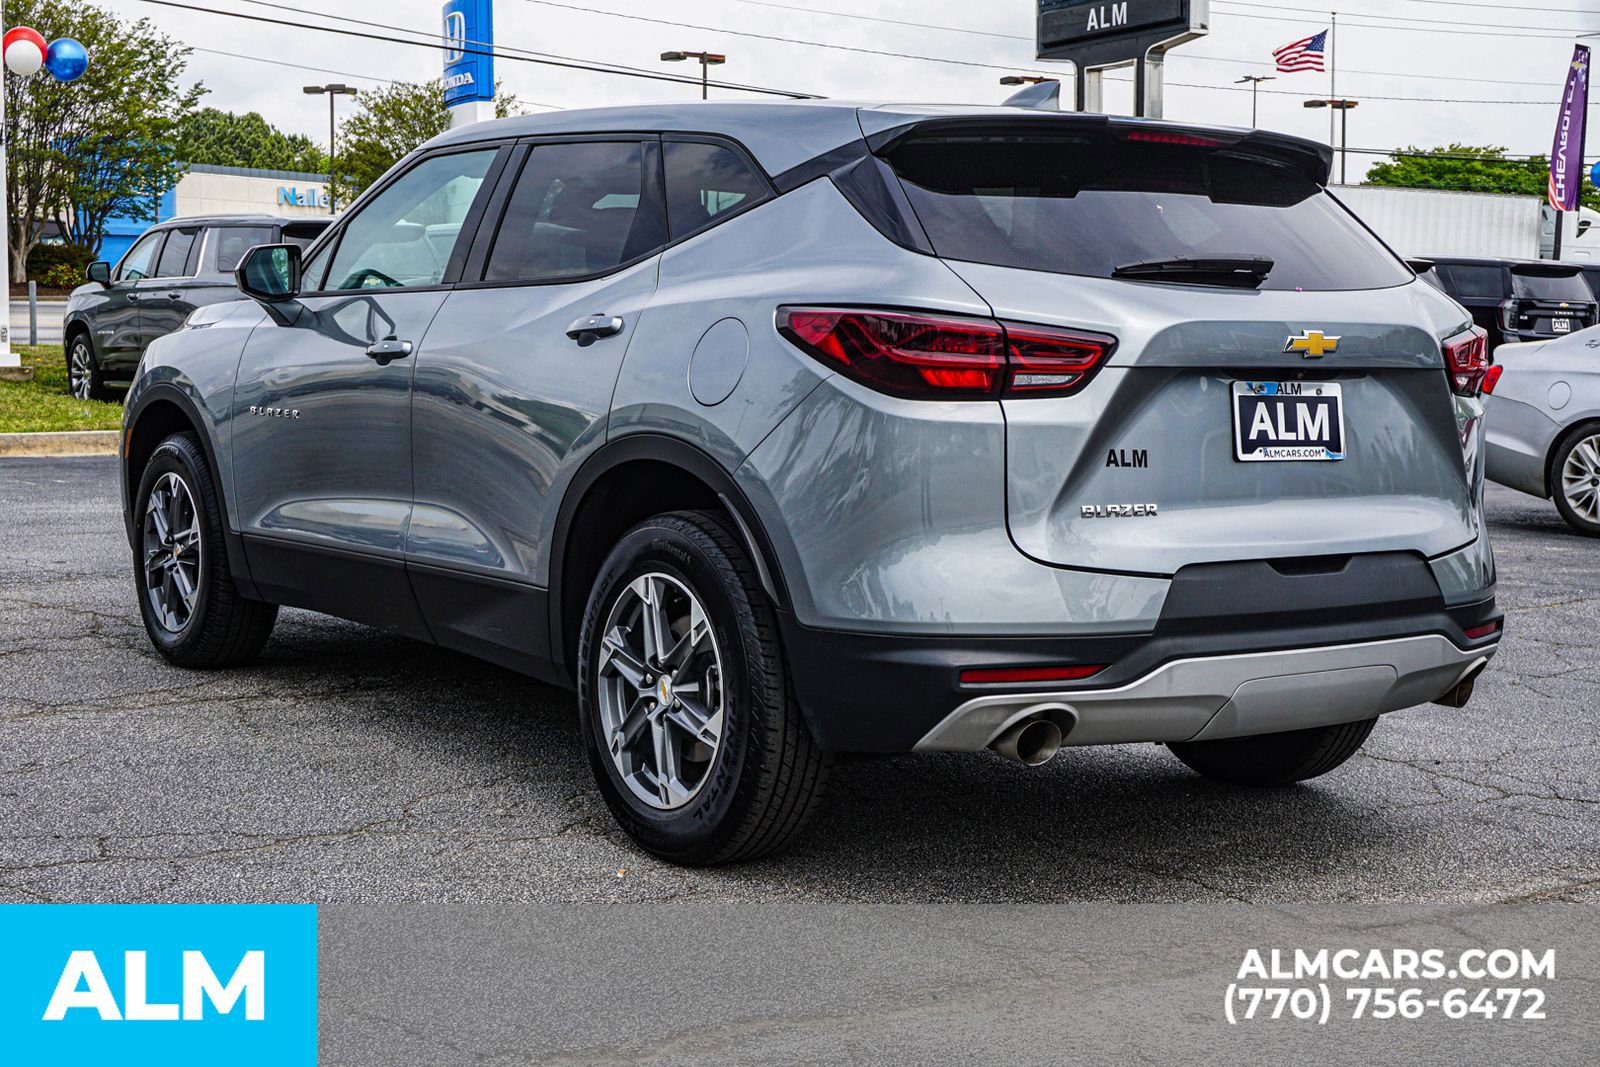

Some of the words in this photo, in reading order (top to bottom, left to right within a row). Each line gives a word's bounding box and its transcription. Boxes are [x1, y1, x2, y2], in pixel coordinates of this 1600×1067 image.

[1087, 2, 1128, 31] ALM
[444, 72, 474, 90] ONDA
[278, 186, 339, 209] Nalle
[1554, 321, 1568, 329] ALM
[1276, 383, 1302, 395] ALM
[250, 406, 300, 419] BLAZER
[1248, 401, 1330, 441] ALM
[1105, 448, 1148, 468] ALM
[1263, 449, 1321, 458] ALMCARS.COM
[1081, 503, 1158, 519] BLAZER
